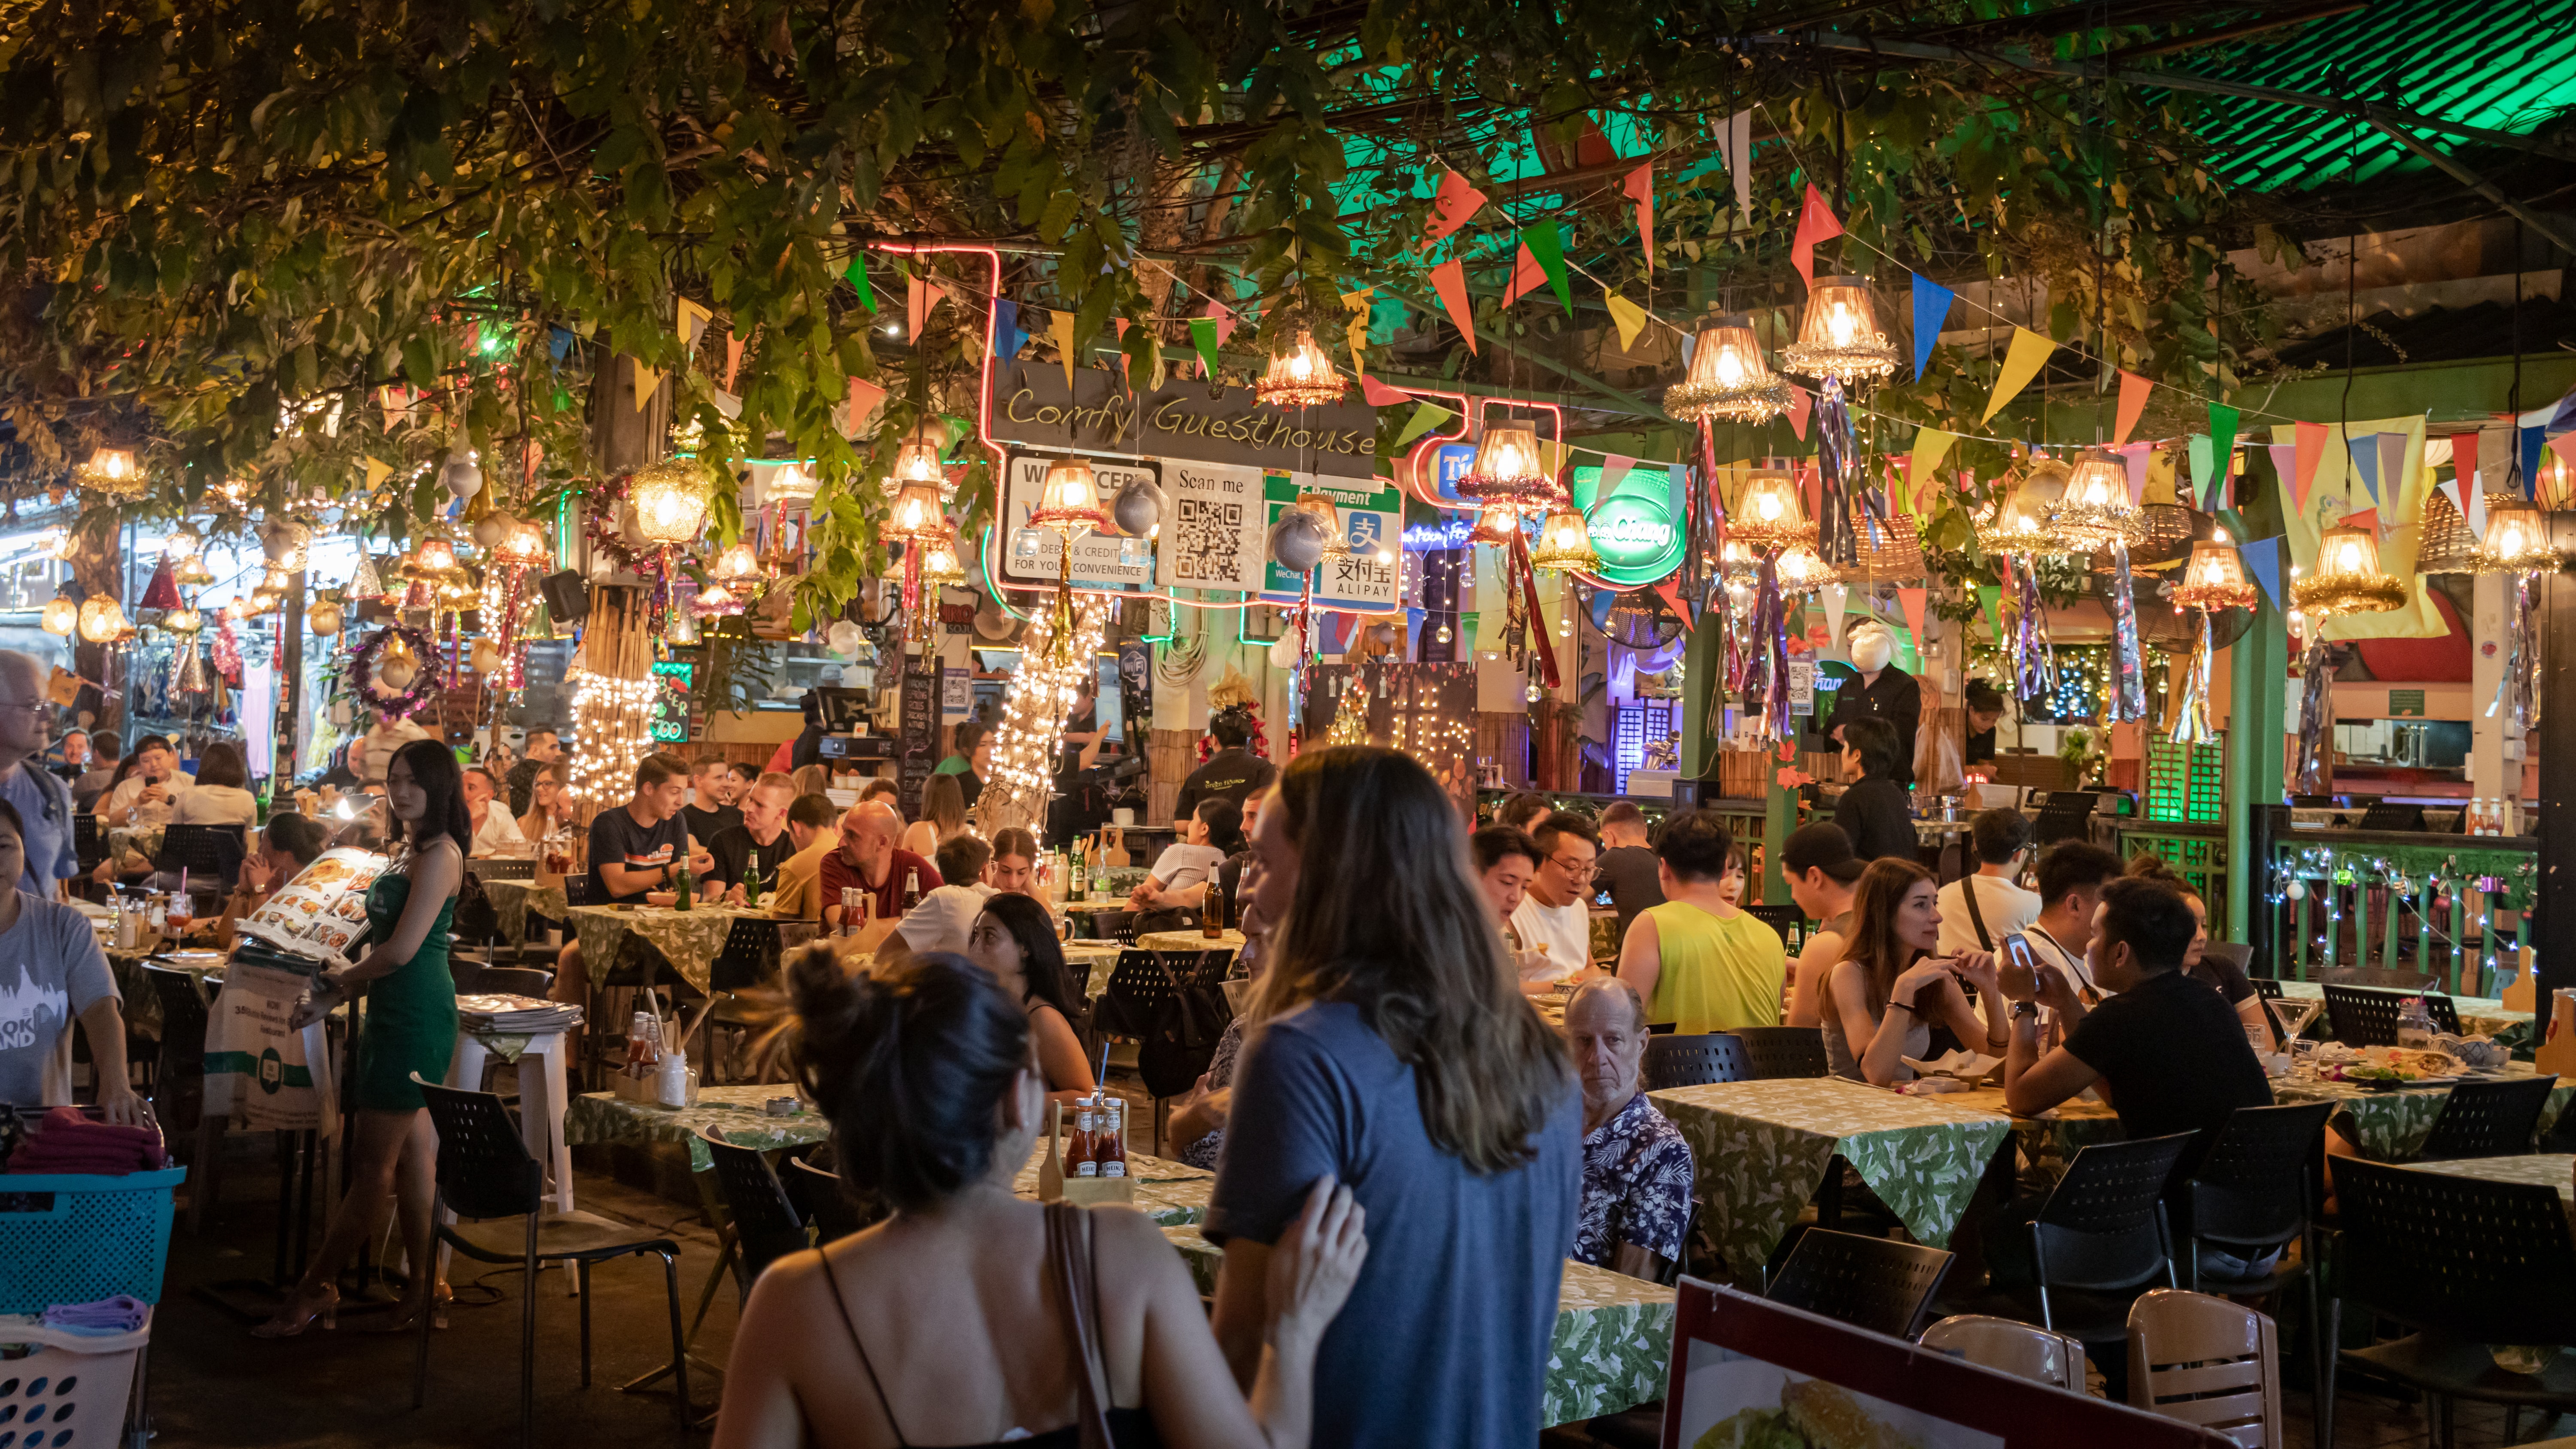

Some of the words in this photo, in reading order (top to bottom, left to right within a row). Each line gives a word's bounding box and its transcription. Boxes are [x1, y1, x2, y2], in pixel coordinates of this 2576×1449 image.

[1008, 388, 1135, 446] Comfy
[1155, 397, 1376, 455] Guesthouse
[1179, 470, 1214, 490] Scan
[1223, 480, 1243, 493] me
[1613, 514, 1671, 547] Chang
[1041, 544, 1060, 554] DEB
[1074, 547, 1080, 556] &
[1085, 547, 1119, 558] CREDIT
[1015, 559, 1035, 570] FOR
[1040, 561, 1060, 571] YOU
[1073, 563, 1142, 577] CONVENIENCE
[1276, 569, 1301, 580] WeChat
[1336, 558, 1391, 584] 支付宝
[1337, 583, 1389, 597] ALIPAY
[948, 625, 974, 634] SOJU
[659, 675, 688, 717] BEER
[0, 1018, 34, 1035] OK
